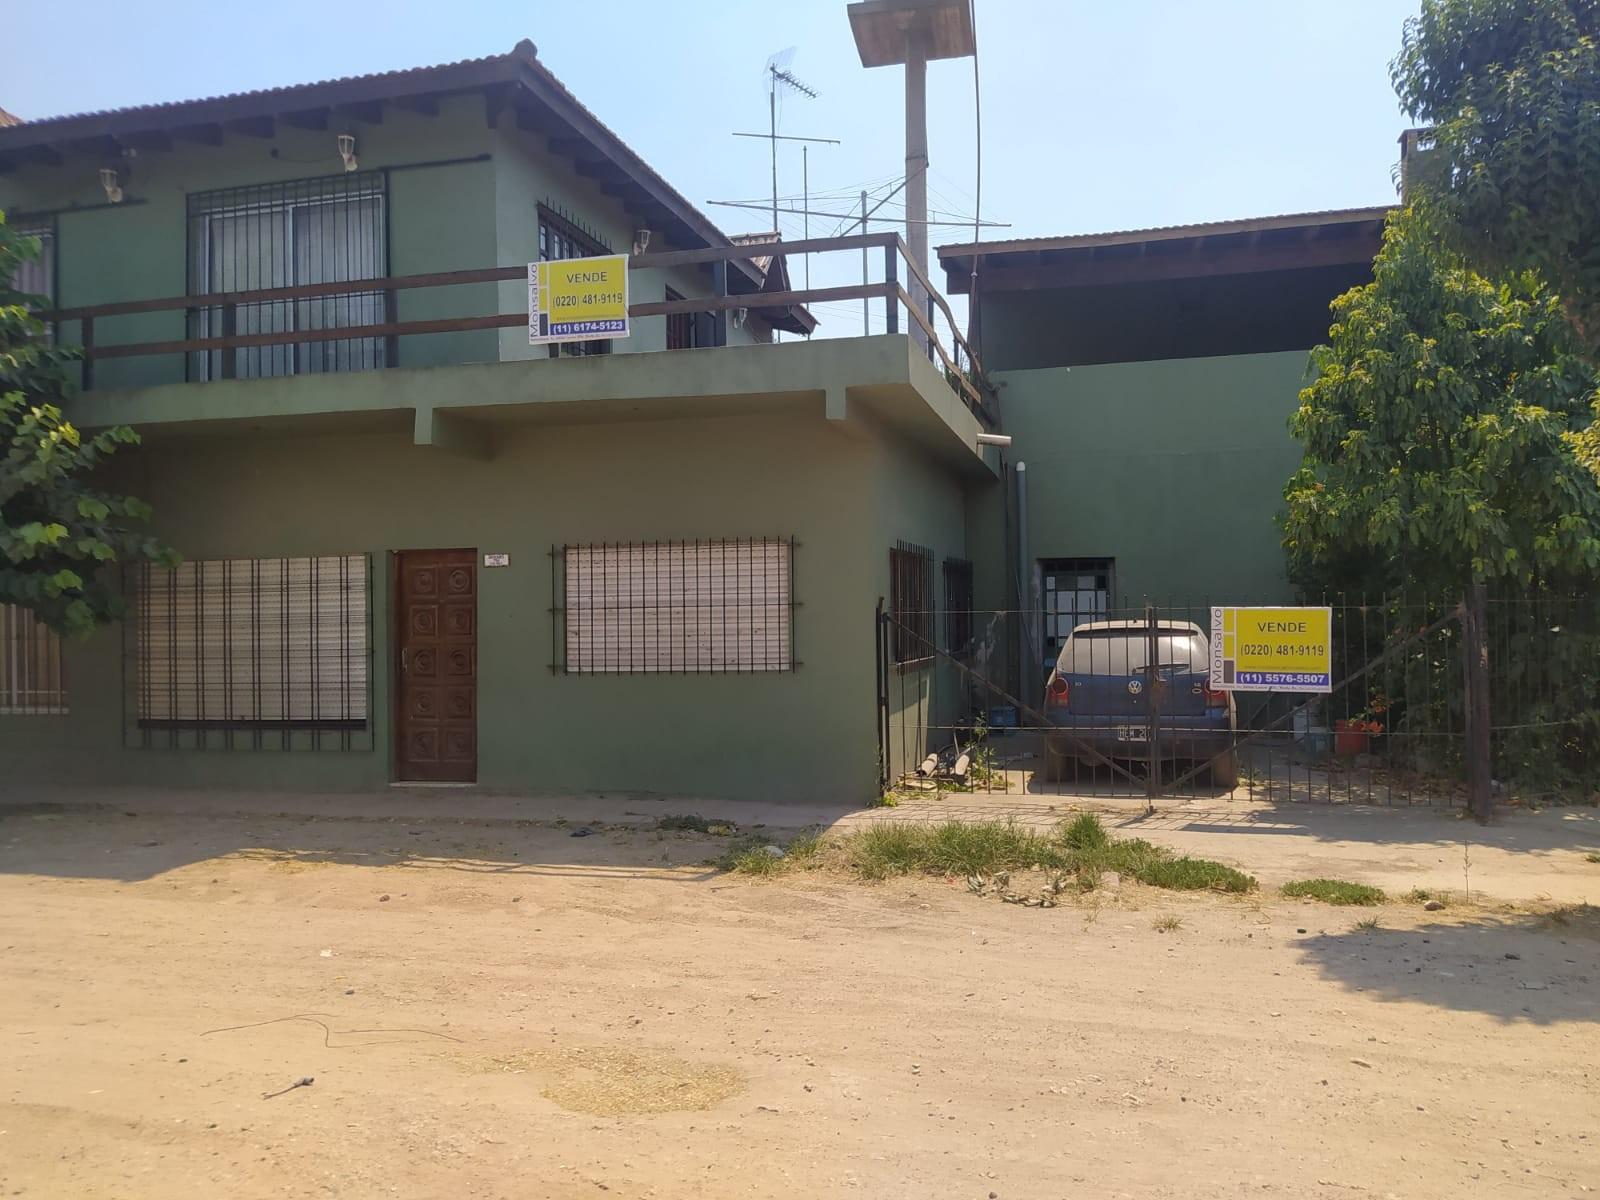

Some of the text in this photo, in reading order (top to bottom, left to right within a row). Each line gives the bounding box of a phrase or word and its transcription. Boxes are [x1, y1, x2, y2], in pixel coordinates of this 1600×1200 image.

[566, 271, 608, 283] VENDE
[529, 264, 538, 337] Monsalvo
[553, 292, 623, 308] (0220) 481-9119
[553, 321, 623, 334] (11) 6174-5123
[1257, 622, 1307, 632] VENDE
[1212, 608, 1222, 684] Monsalvo
[1240, 644, 1324, 658] (0220) 481-9119
[1240, 673, 1325, 684] (11) 5576-5507
